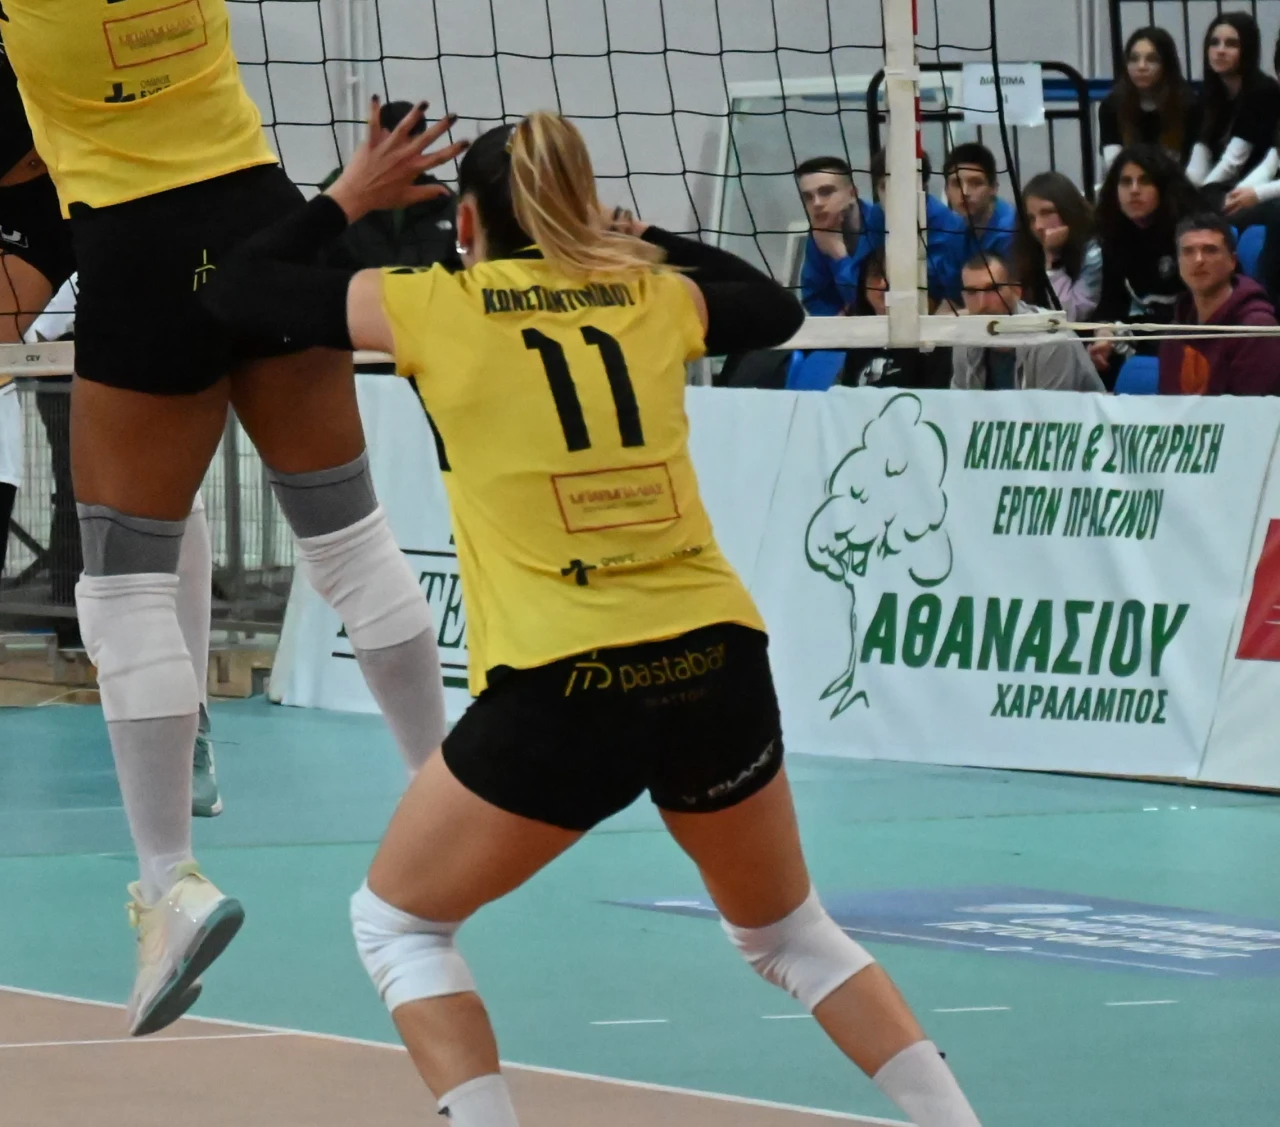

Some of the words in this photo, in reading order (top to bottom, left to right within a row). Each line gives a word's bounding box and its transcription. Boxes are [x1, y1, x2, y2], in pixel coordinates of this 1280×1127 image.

[521, 325, 645, 452] 11
[1081, 423, 1104, 472] &
[993, 486, 1063, 535] ΕΡΓΩΝ
[1063, 487, 1164, 540] ΠΡΑΣΙΝΟΥ
[860, 592, 1190, 677] ΑΘΑΝΑΣΙΟΥ
[619, 643, 724, 693] pastabar
[990, 683, 1169, 724] ΧΑΡΑΛΑΜΠΟΣ
